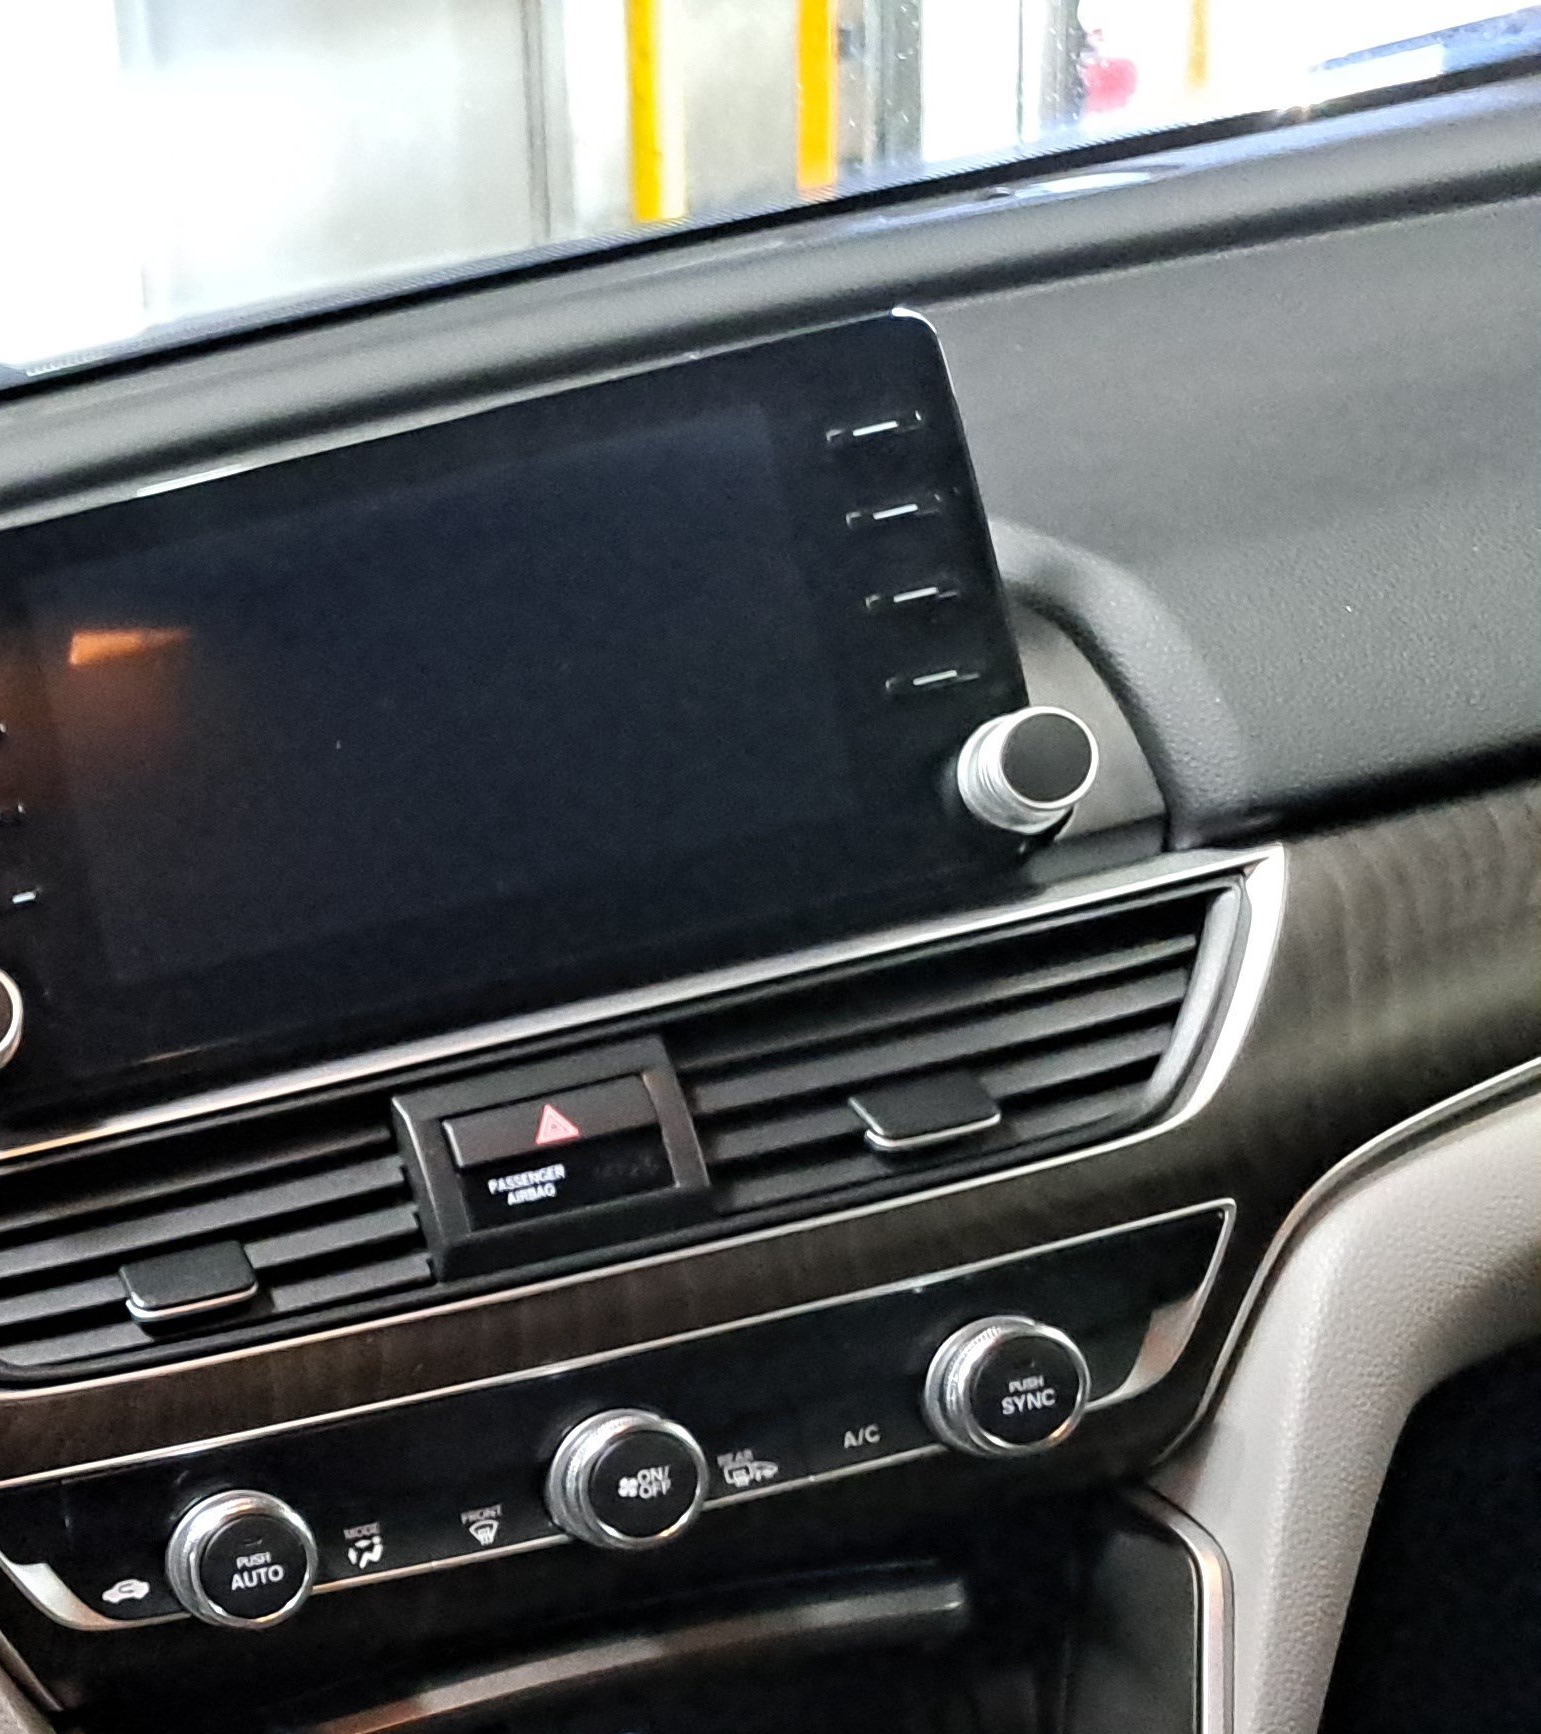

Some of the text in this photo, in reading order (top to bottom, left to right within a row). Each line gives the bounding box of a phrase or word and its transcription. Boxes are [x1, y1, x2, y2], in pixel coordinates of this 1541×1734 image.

[487, 1163, 566, 1196] PASSENGER
[507, 1182, 557, 1206] AIRBAG
[1001, 1387, 1056, 1415] SYNC
[843, 1424, 881, 1449] A/C
[460, 1503, 503, 1526] FRONT
[343, 1521, 381, 1540] MODE
[236, 1551, 272, 1570] PUSH
[230, 1563, 285, 1591] AUTO
